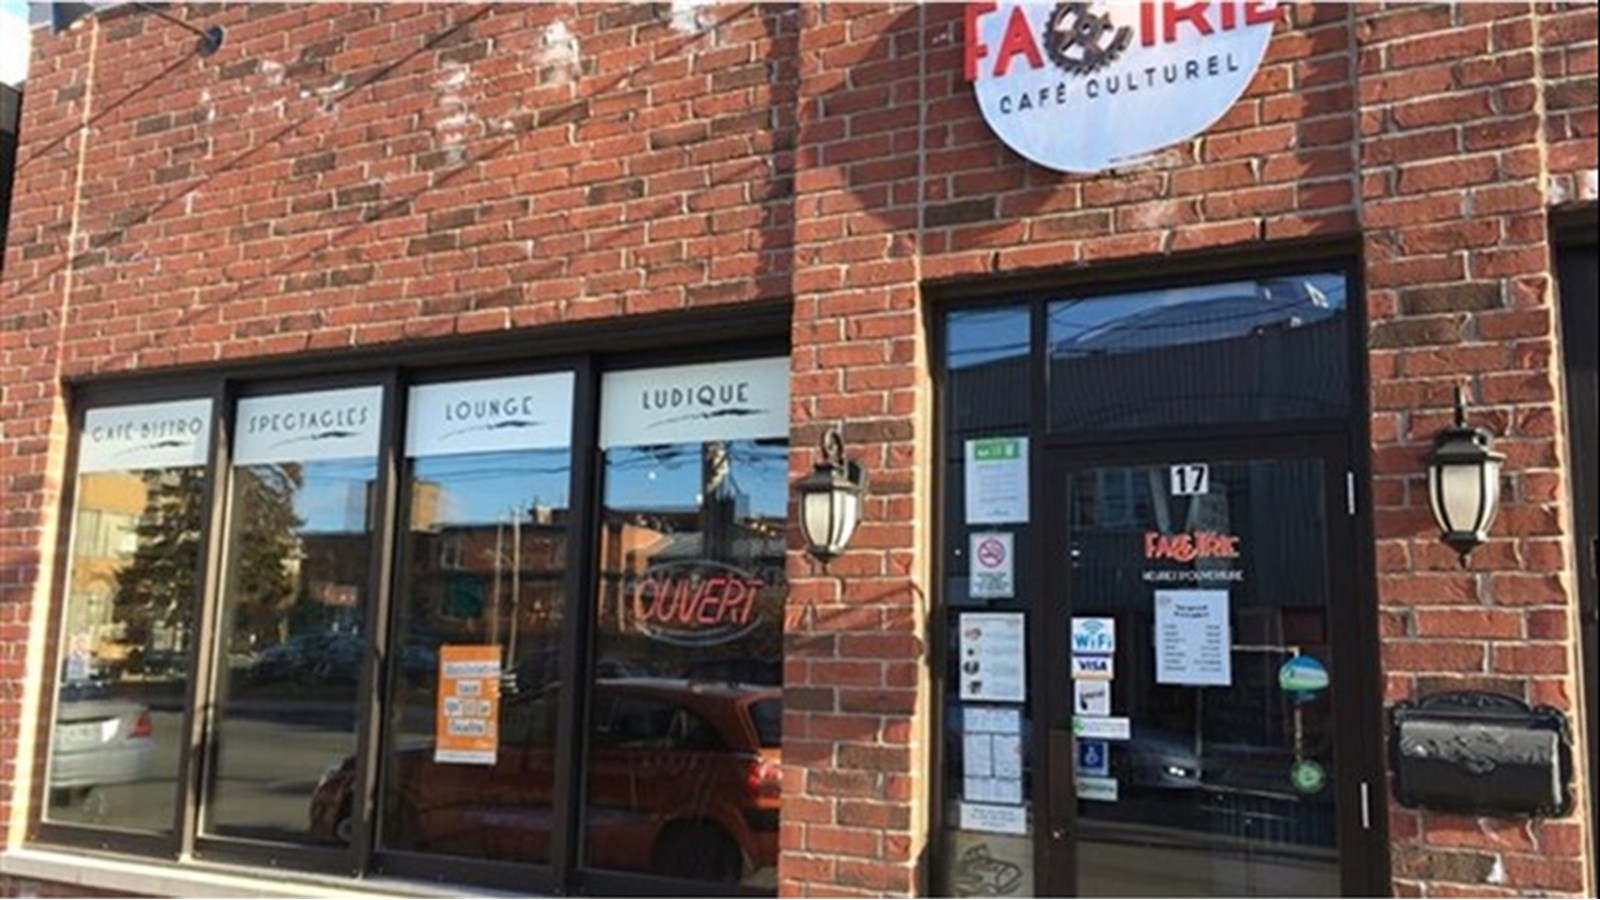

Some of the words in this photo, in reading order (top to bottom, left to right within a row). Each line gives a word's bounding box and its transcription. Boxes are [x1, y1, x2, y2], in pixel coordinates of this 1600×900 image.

[999, 82, 1067, 115] CAFÉ
[1086, 53, 1239, 98] CULTUREL
[444, 395, 535, 422] LOUNGE
[642, 382, 750, 411] LUDIQUE
[140, 416, 203, 438] BISTRO
[248, 406, 368, 433] SPECTACLES
[1175, 467, 1206, 494] 17
[634, 577, 764, 625] OUVERT
[1078, 660, 1108, 671] VISA
